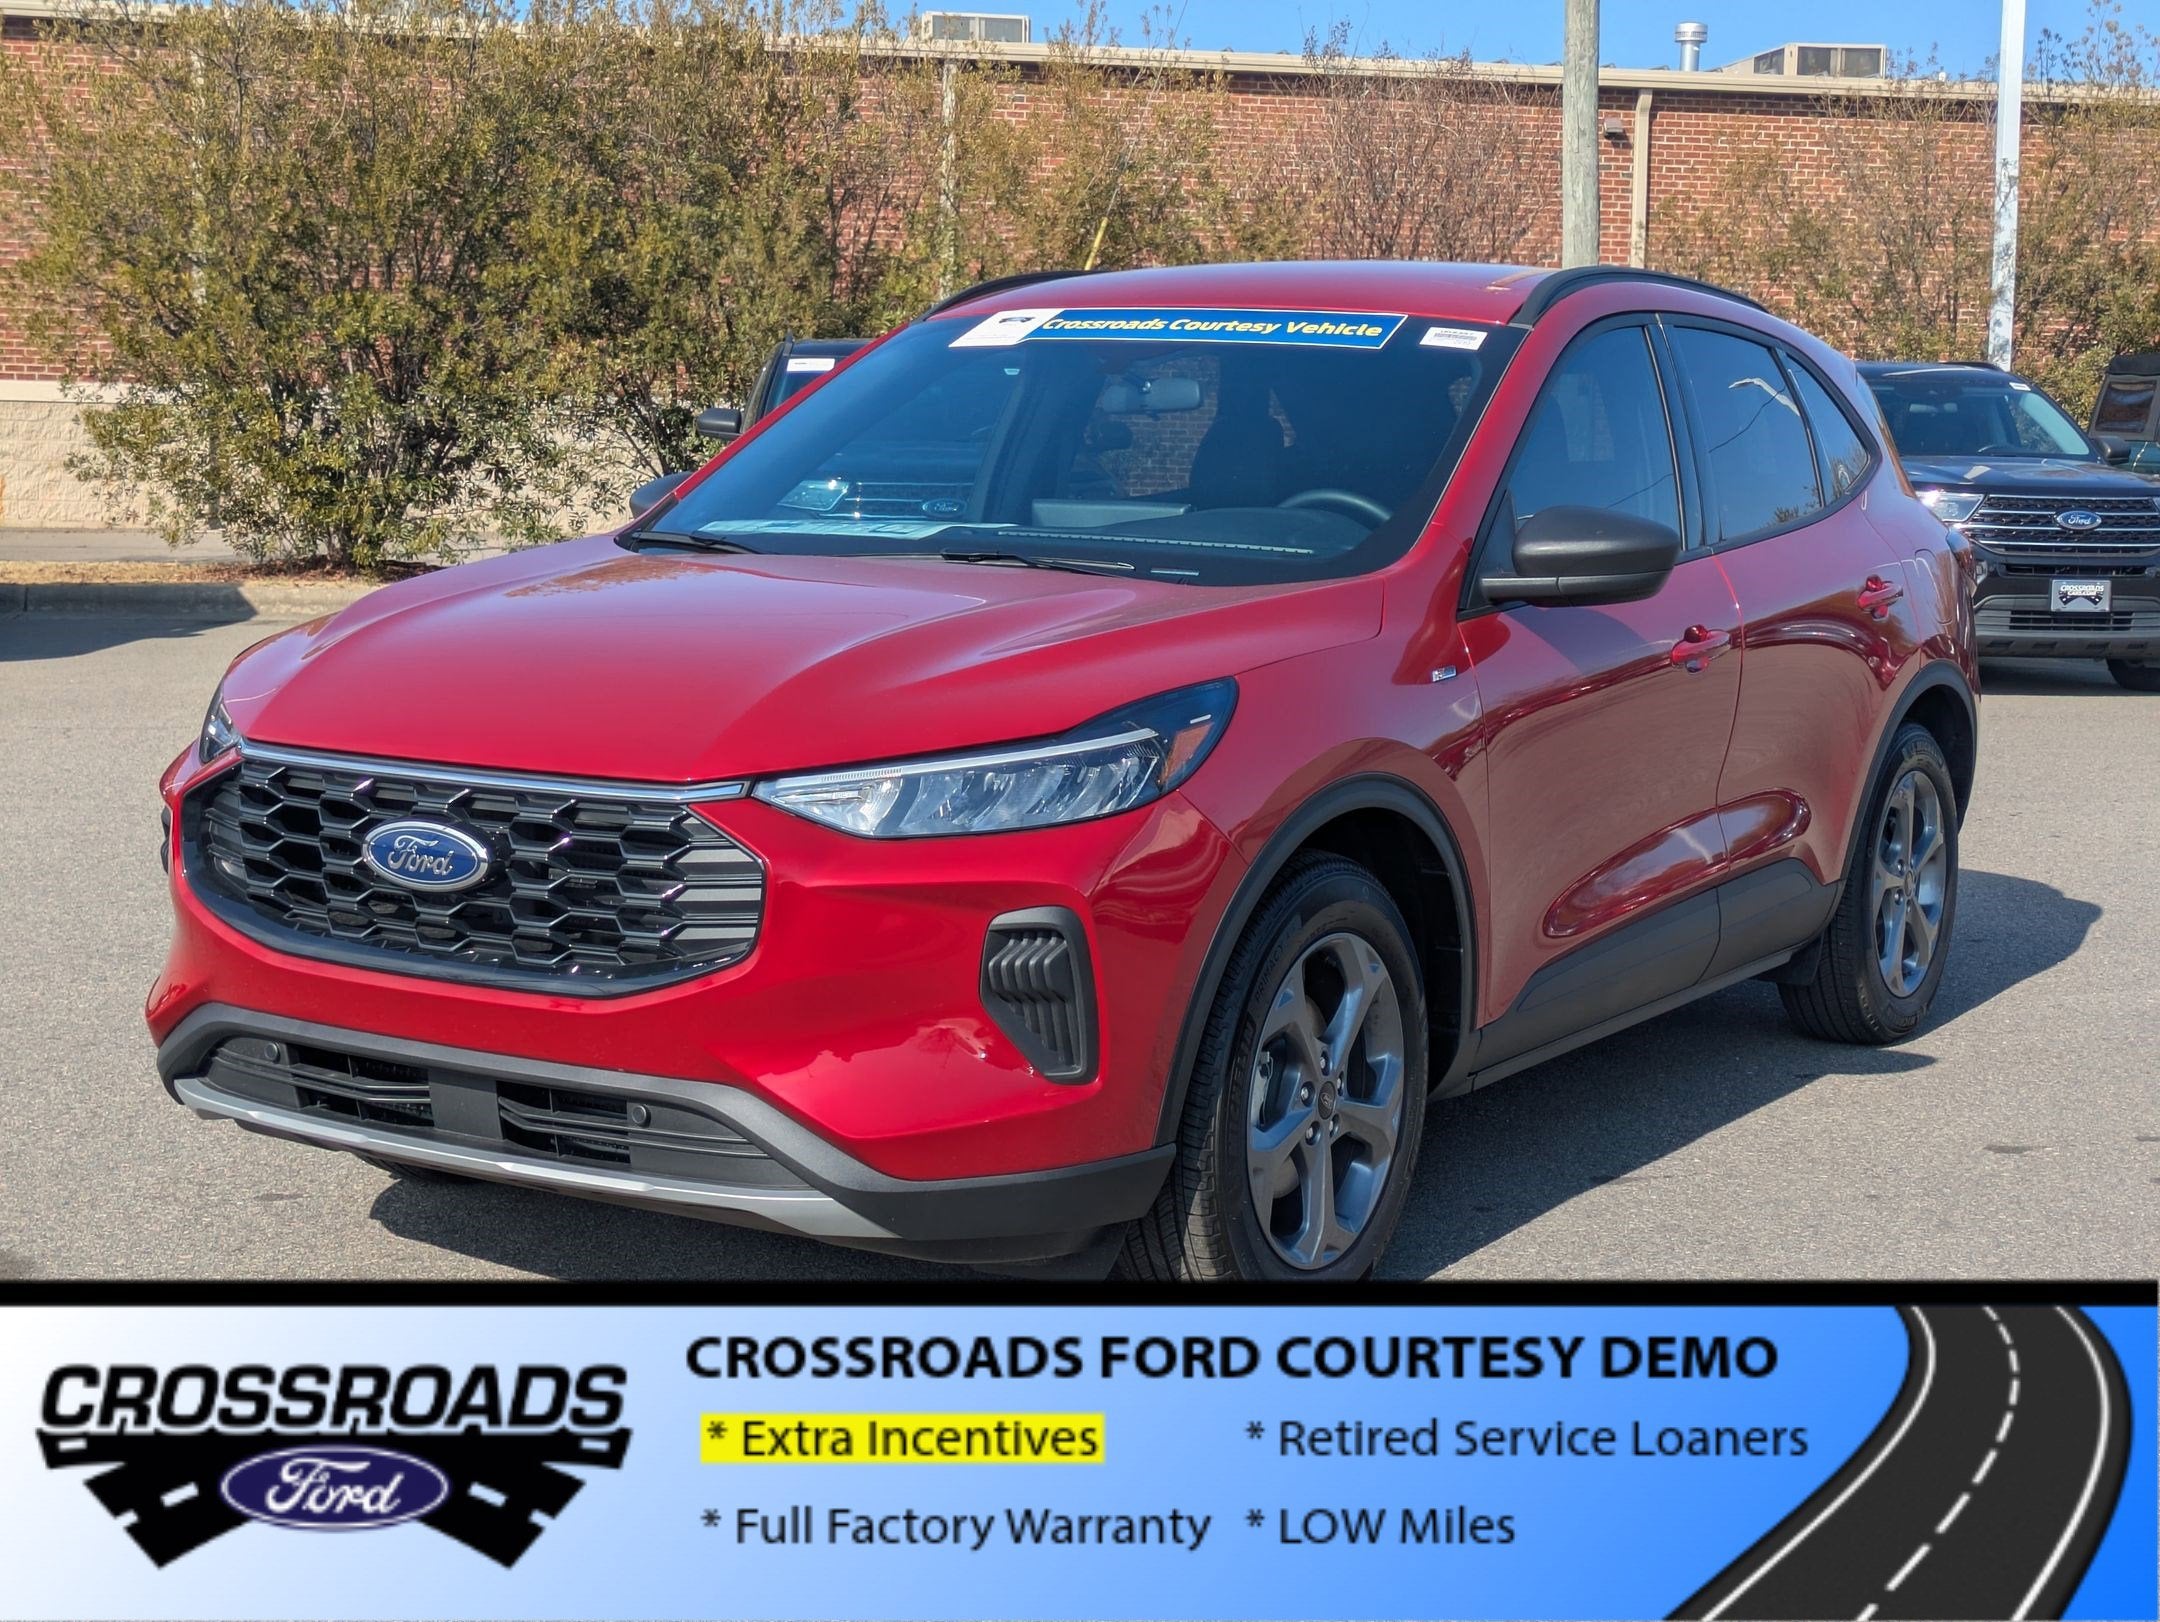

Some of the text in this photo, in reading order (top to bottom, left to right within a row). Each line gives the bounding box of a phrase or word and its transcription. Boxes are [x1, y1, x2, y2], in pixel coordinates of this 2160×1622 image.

[1042, 318, 1384, 337] Crossroads Courtesy Vehicle
[2068, 513, 2092, 525] Ford
[387, 834, 455, 876] Ford
